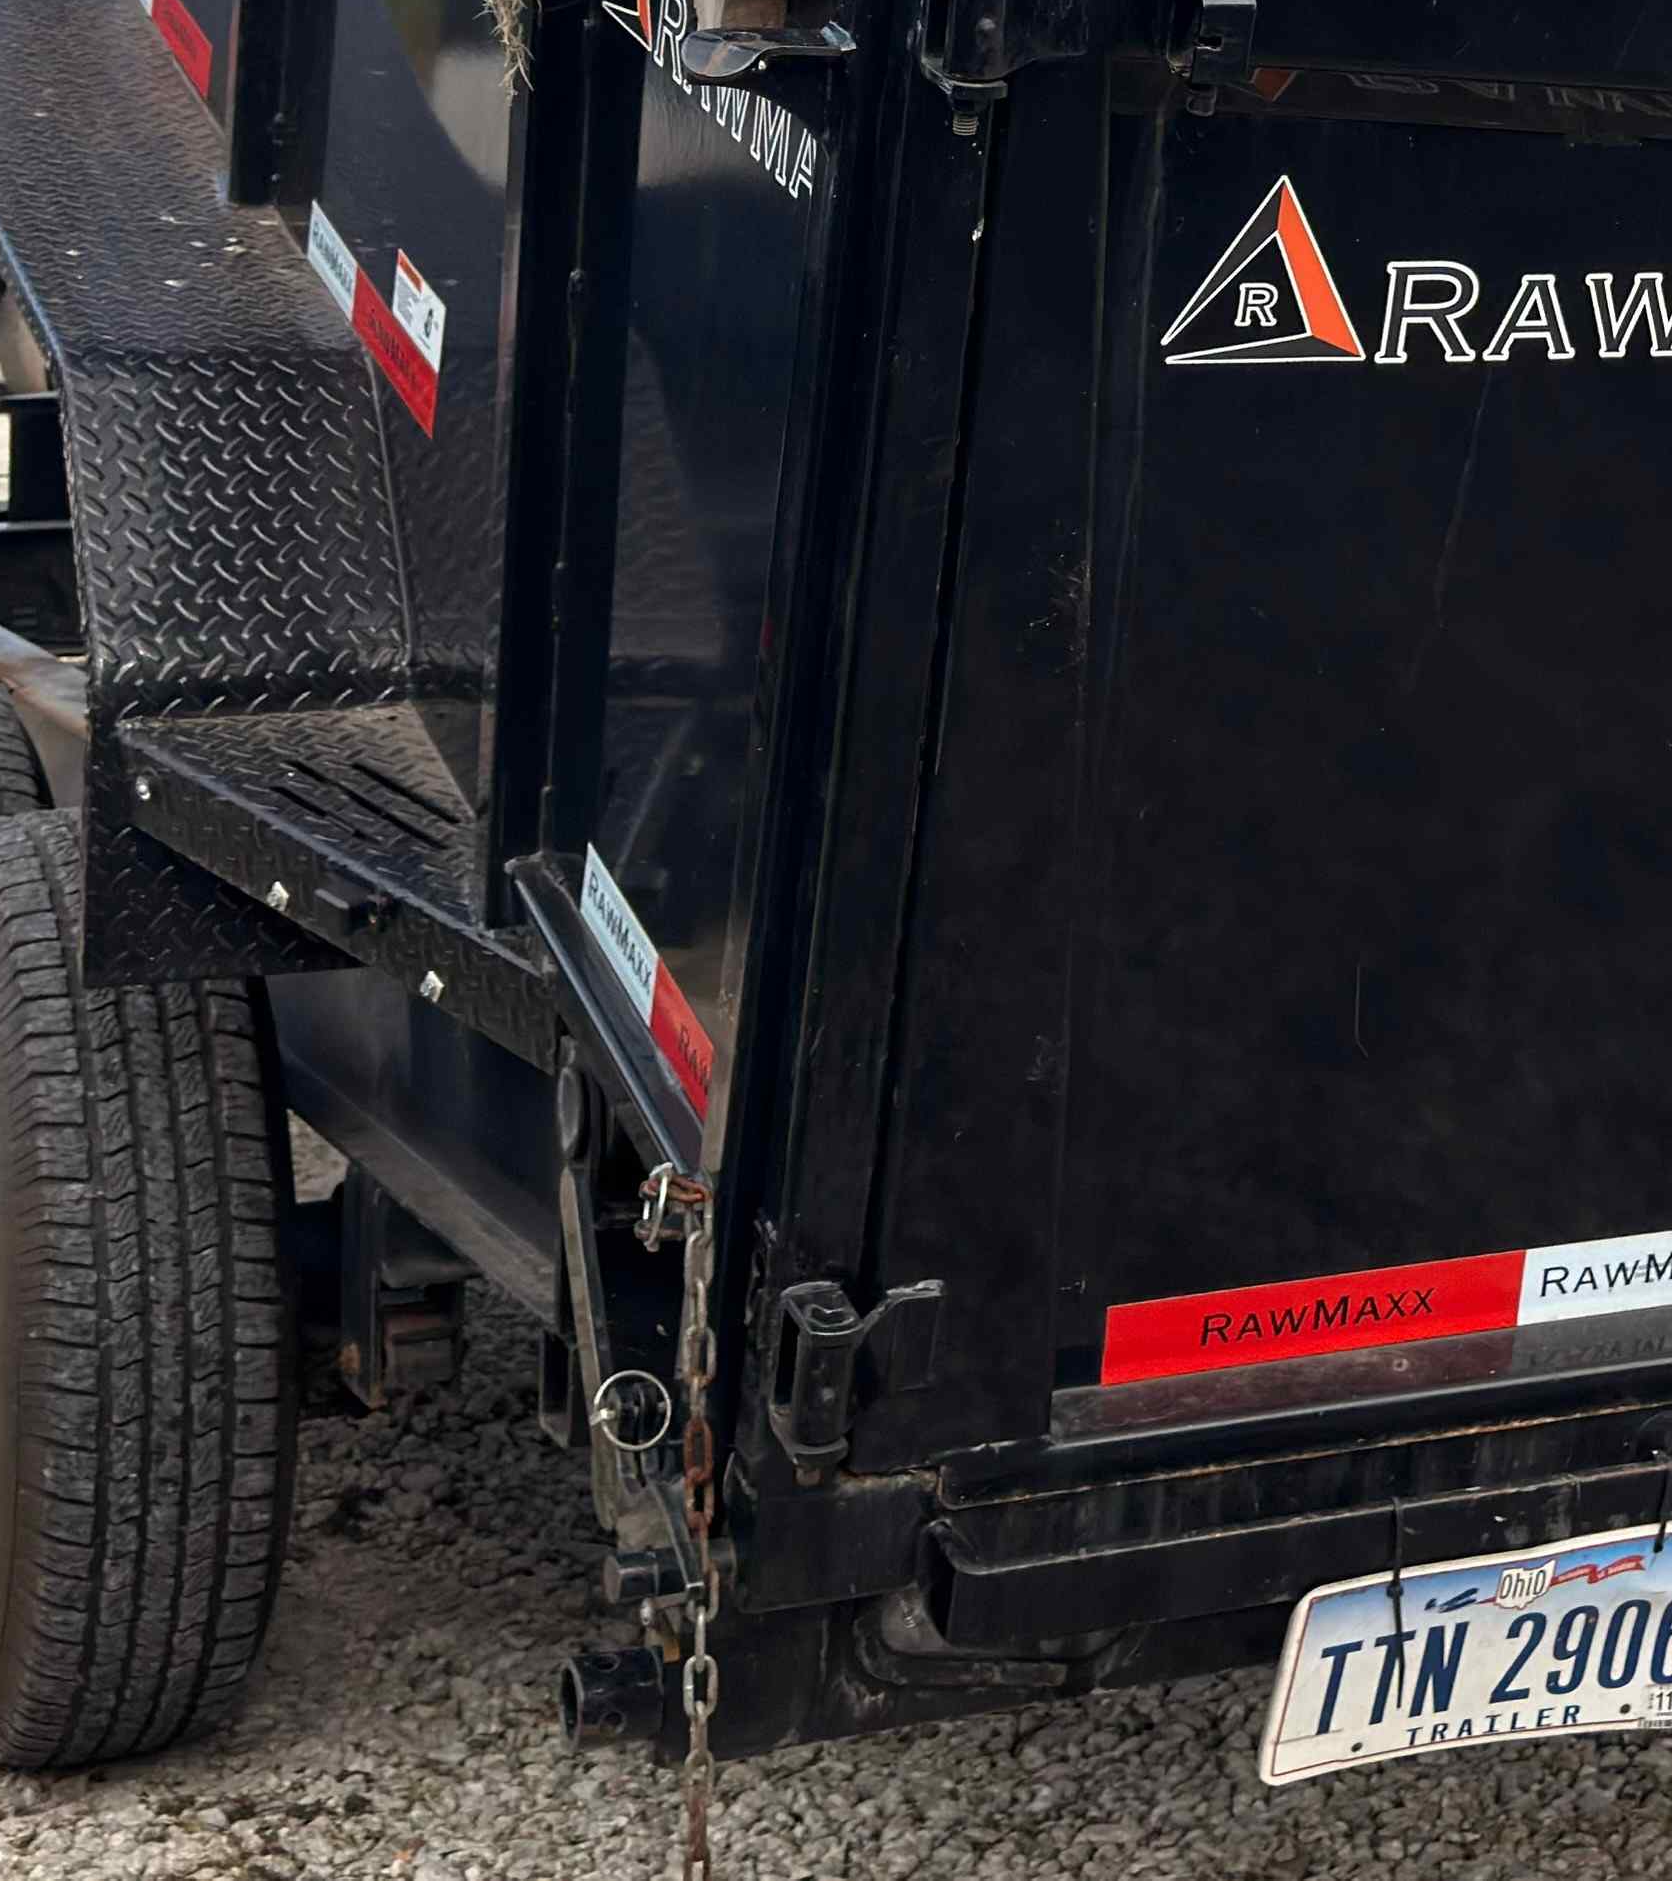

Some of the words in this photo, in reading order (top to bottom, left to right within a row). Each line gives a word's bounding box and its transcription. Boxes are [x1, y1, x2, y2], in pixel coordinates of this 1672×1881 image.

[1200, 1288, 1437, 1347] RAWMAXX
[1315, 1621, 1470, 1735] TTN
[1408, 1704, 1582, 1746] TRAILER
